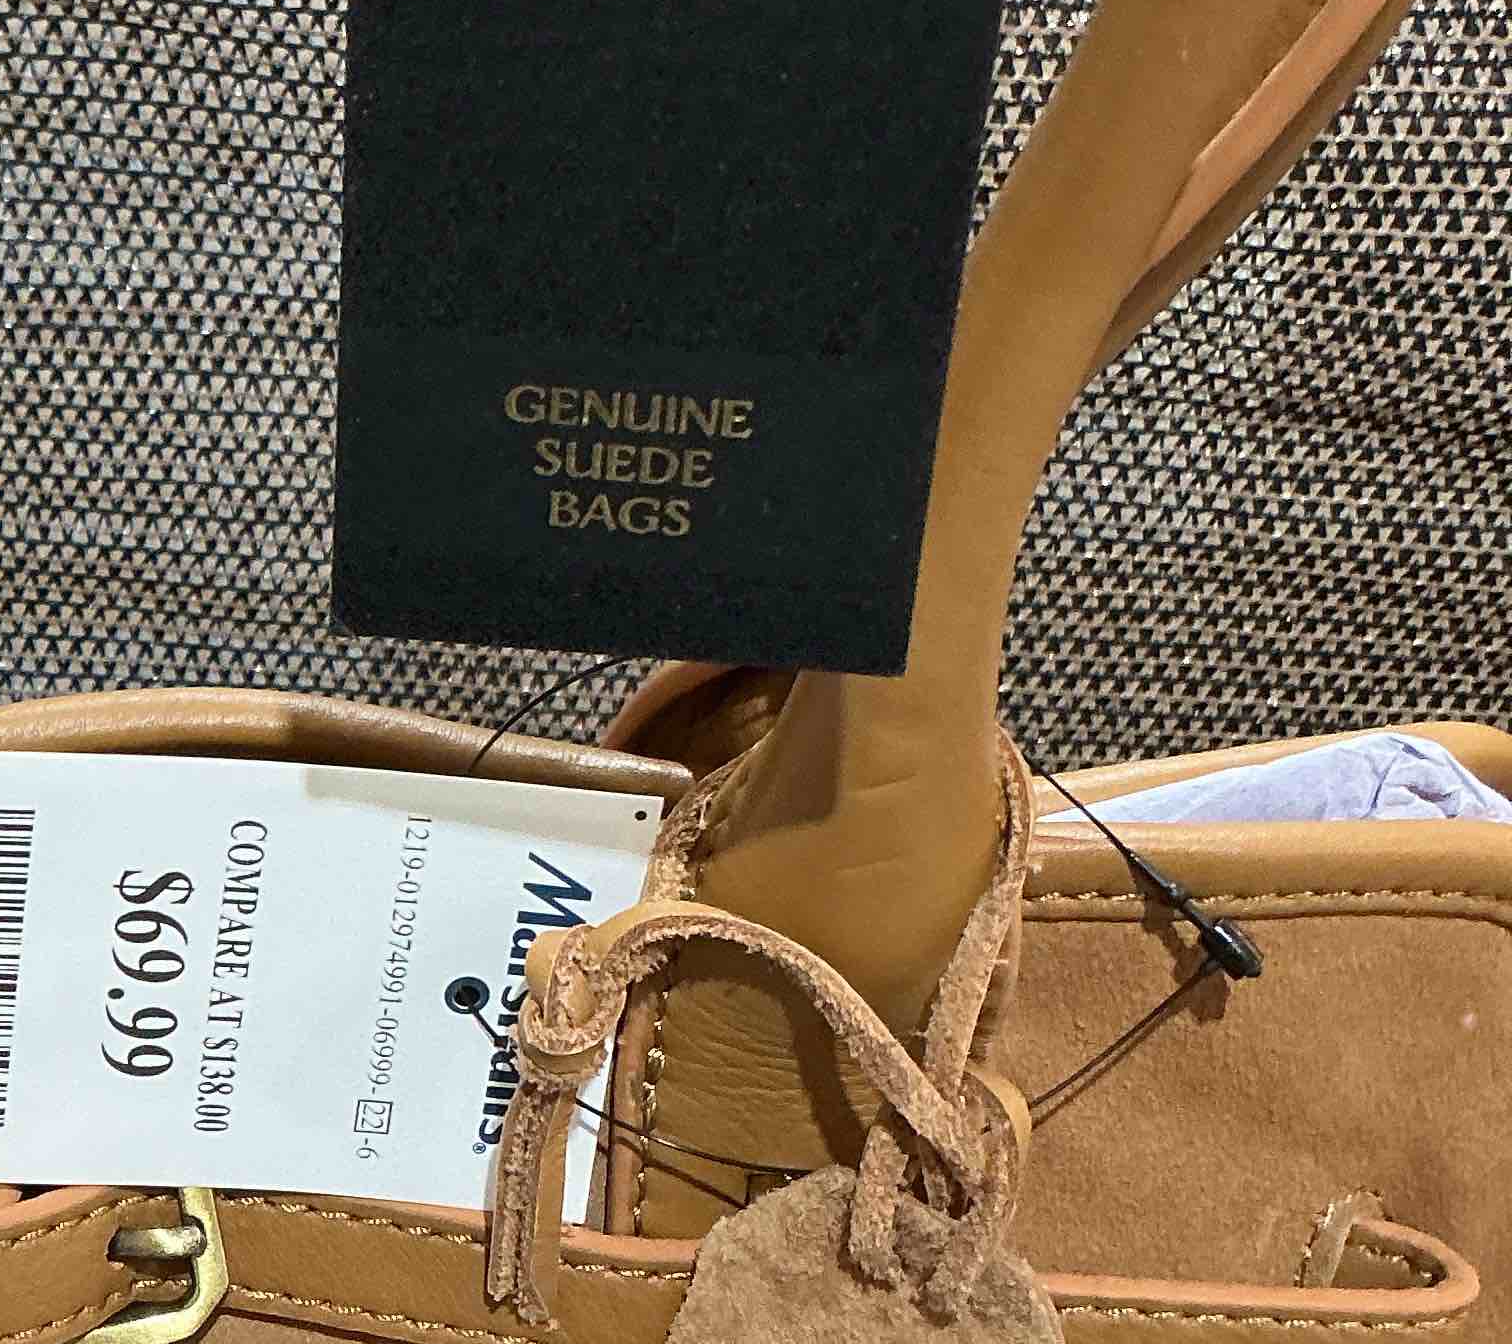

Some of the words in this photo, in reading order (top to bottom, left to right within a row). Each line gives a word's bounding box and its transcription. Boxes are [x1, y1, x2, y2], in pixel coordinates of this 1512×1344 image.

[503, 384, 753, 439] GENUINE
[533, 438, 714, 488] SUEDE
[548, 490, 691, 536] BAGS
[212, 819, 268, 979] COMPARE
[100, 869, 196, 1078] $69.99
[206, 987, 246, 1030] AT
[193, 1036, 239, 1133] $138.00
